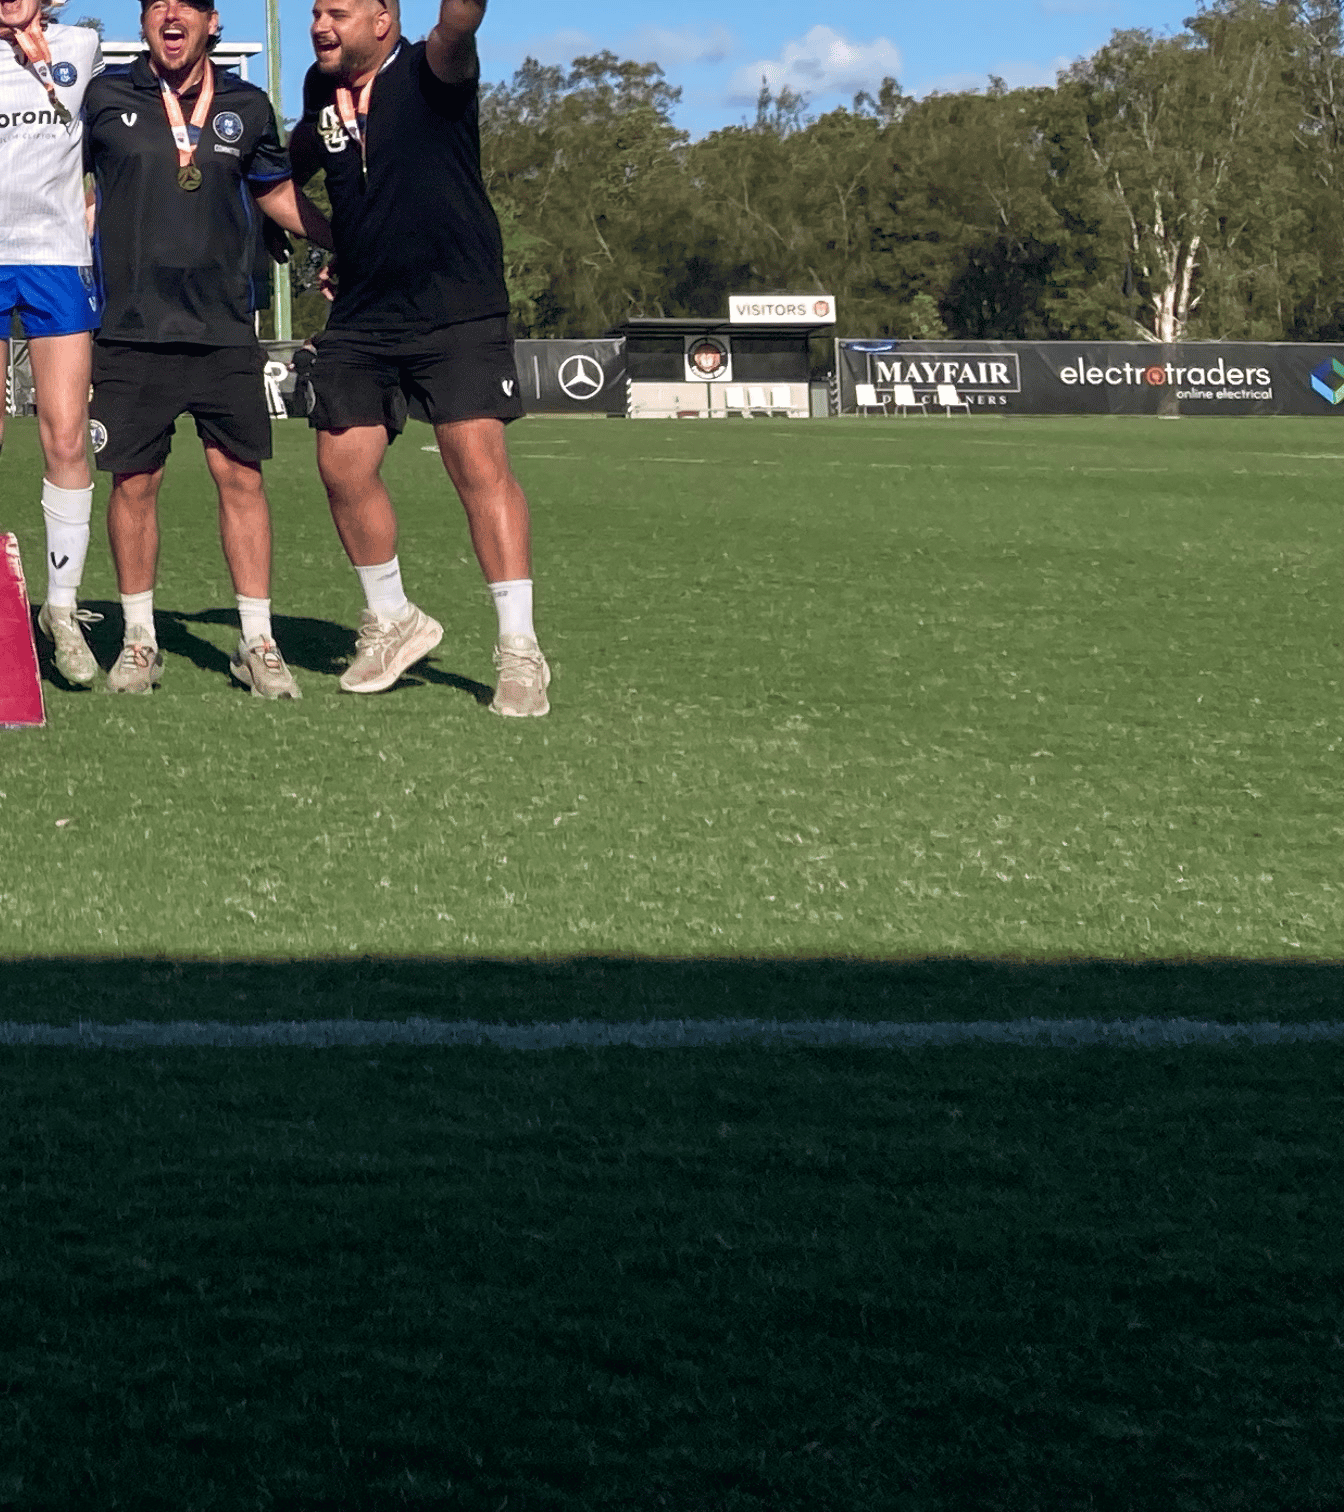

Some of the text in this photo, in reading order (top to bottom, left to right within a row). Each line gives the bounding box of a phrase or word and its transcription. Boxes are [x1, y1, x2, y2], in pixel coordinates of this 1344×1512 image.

[735, 302, 807, 317] VISITORS
[876, 361, 1011, 384] MAYFAIR
[1176, 388, 1273, 400] online electrical
